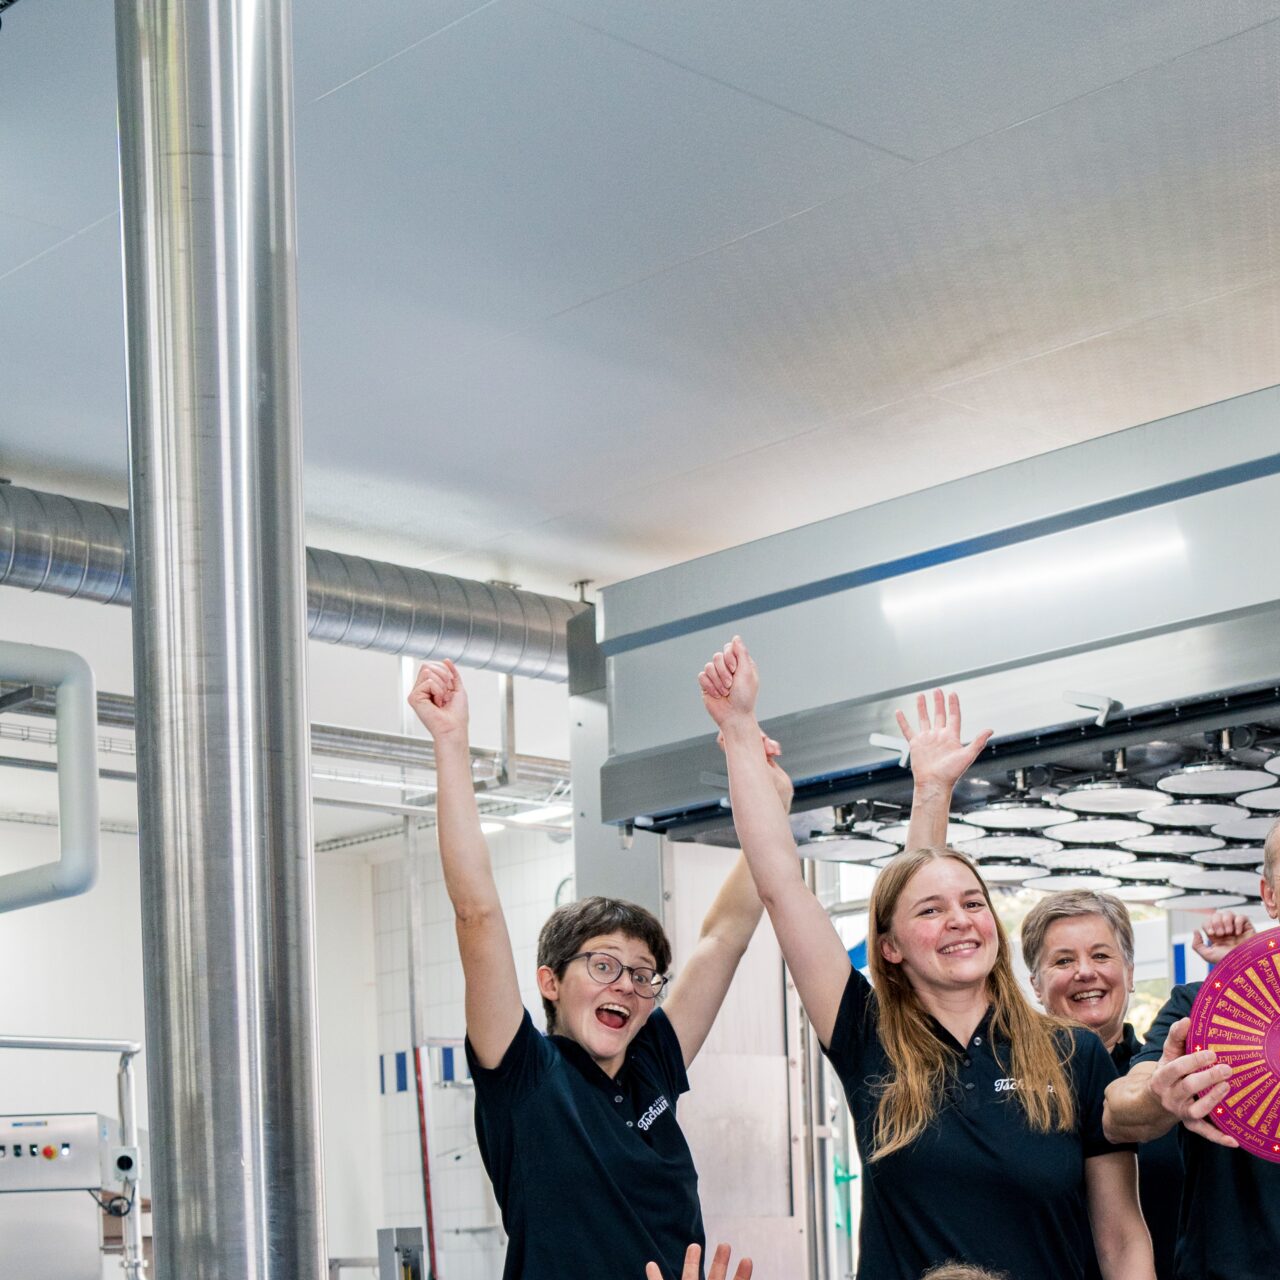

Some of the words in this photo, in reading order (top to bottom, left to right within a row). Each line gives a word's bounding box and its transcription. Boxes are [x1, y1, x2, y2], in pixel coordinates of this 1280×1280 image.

[1241, 983, 1274, 1018] Appenzeller
[1225, 1005, 1265, 1030] Appenzeller
[1217, 1030, 1262, 1044] Appenzeller
[1227, 1066, 1267, 1087] Appenzelle
[1240, 1079, 1277, 1111] Appenzeller
